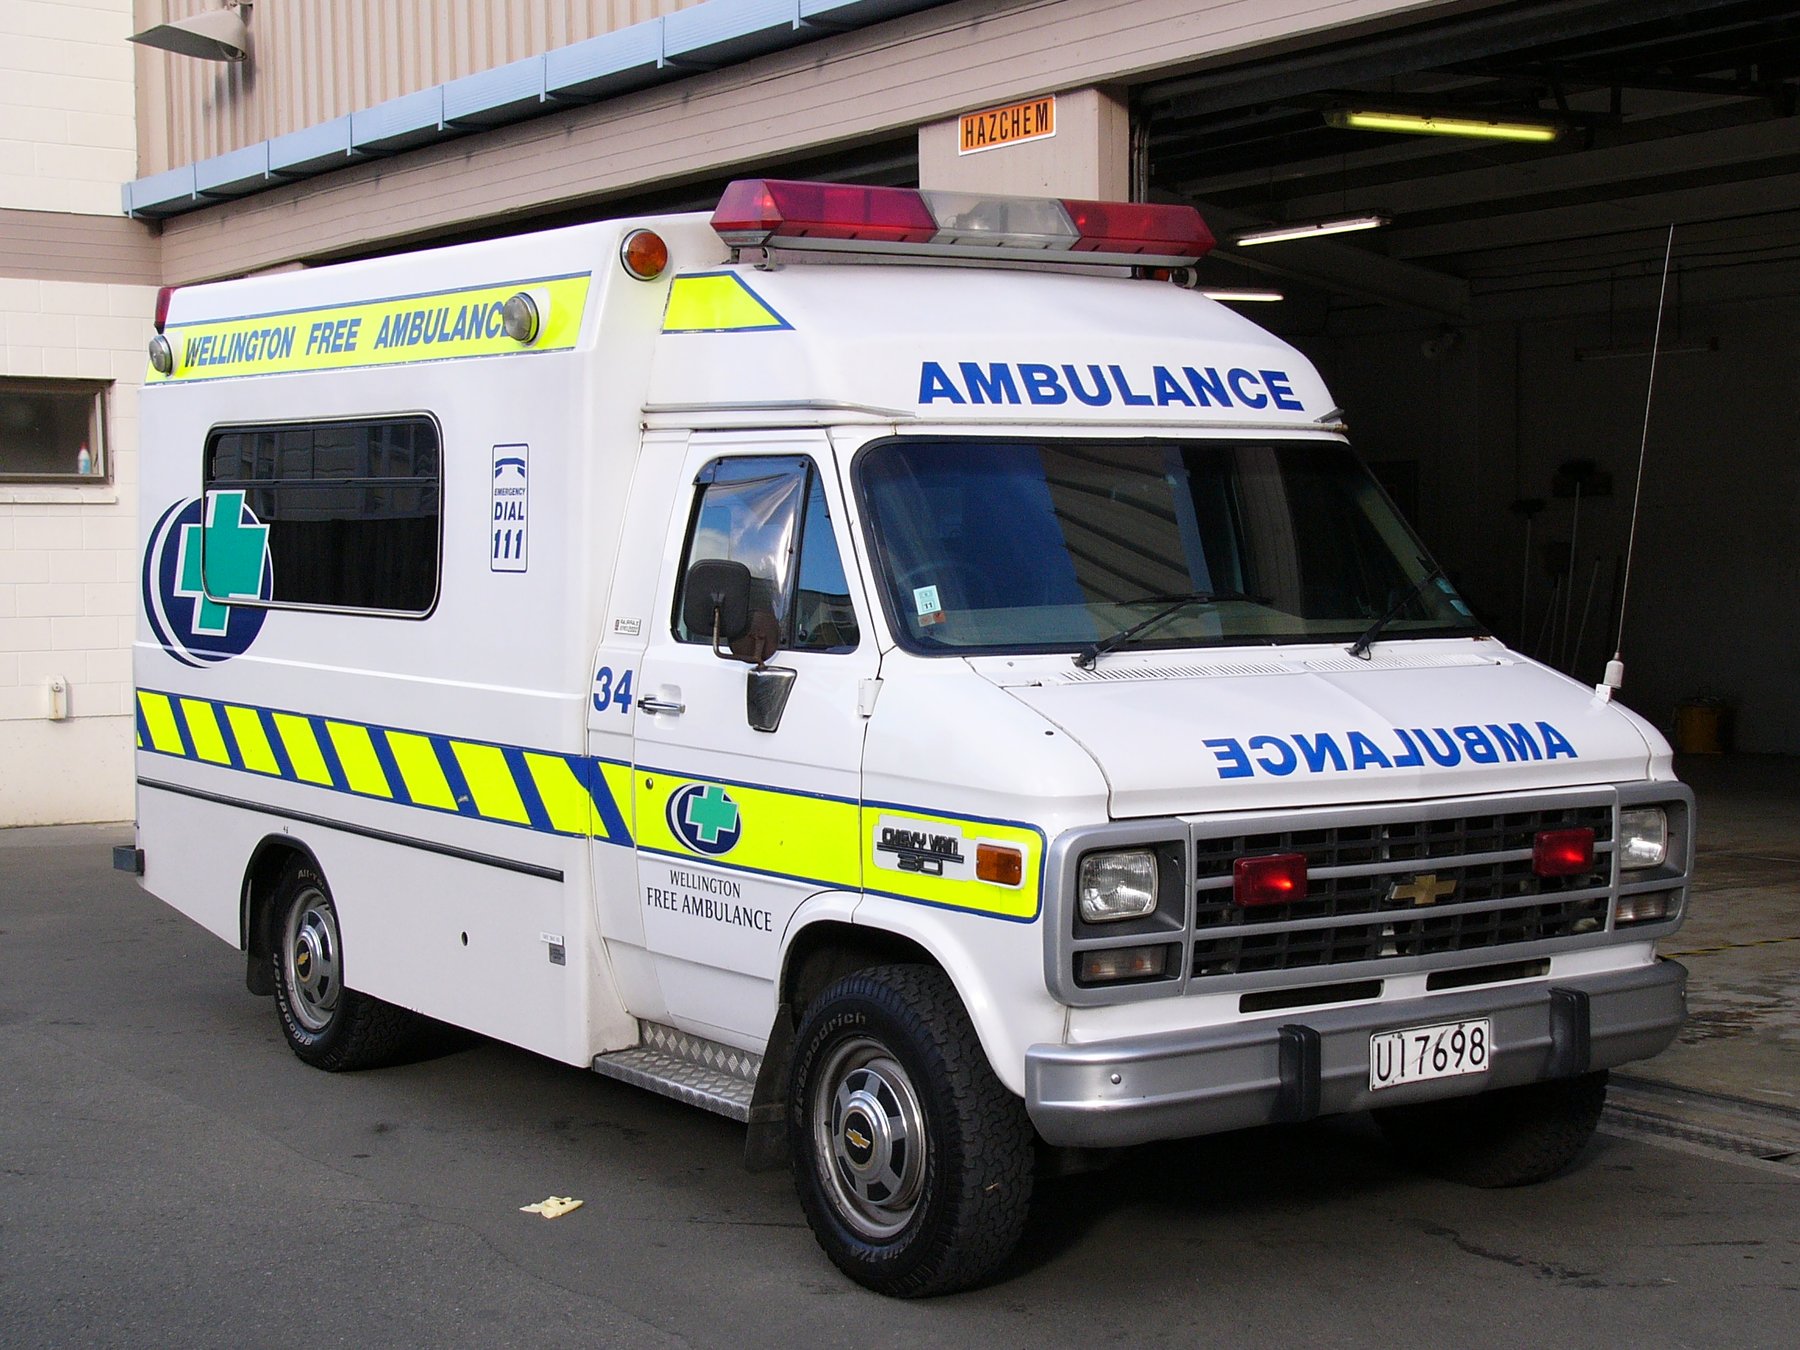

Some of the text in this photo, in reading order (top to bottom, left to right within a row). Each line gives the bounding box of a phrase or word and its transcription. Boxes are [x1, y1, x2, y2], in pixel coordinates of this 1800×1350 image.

[965, 101, 1048, 148] HAZCHEM
[184, 326, 296, 368] WELLINGTON
[305, 318, 362, 356] FREE
[918, 361, 1305, 411] AMBULANCE
[494, 487, 526, 496] EMERGENCY
[494, 501, 525, 520] DIAL
[493, 529, 523, 559] 111
[593, 666, 633, 714] 34
[881, 827, 927, 850] CHEVY
[670, 869, 741, 899] WELLINGTON
[646, 887, 773, 932] FREE AMBULANCE
